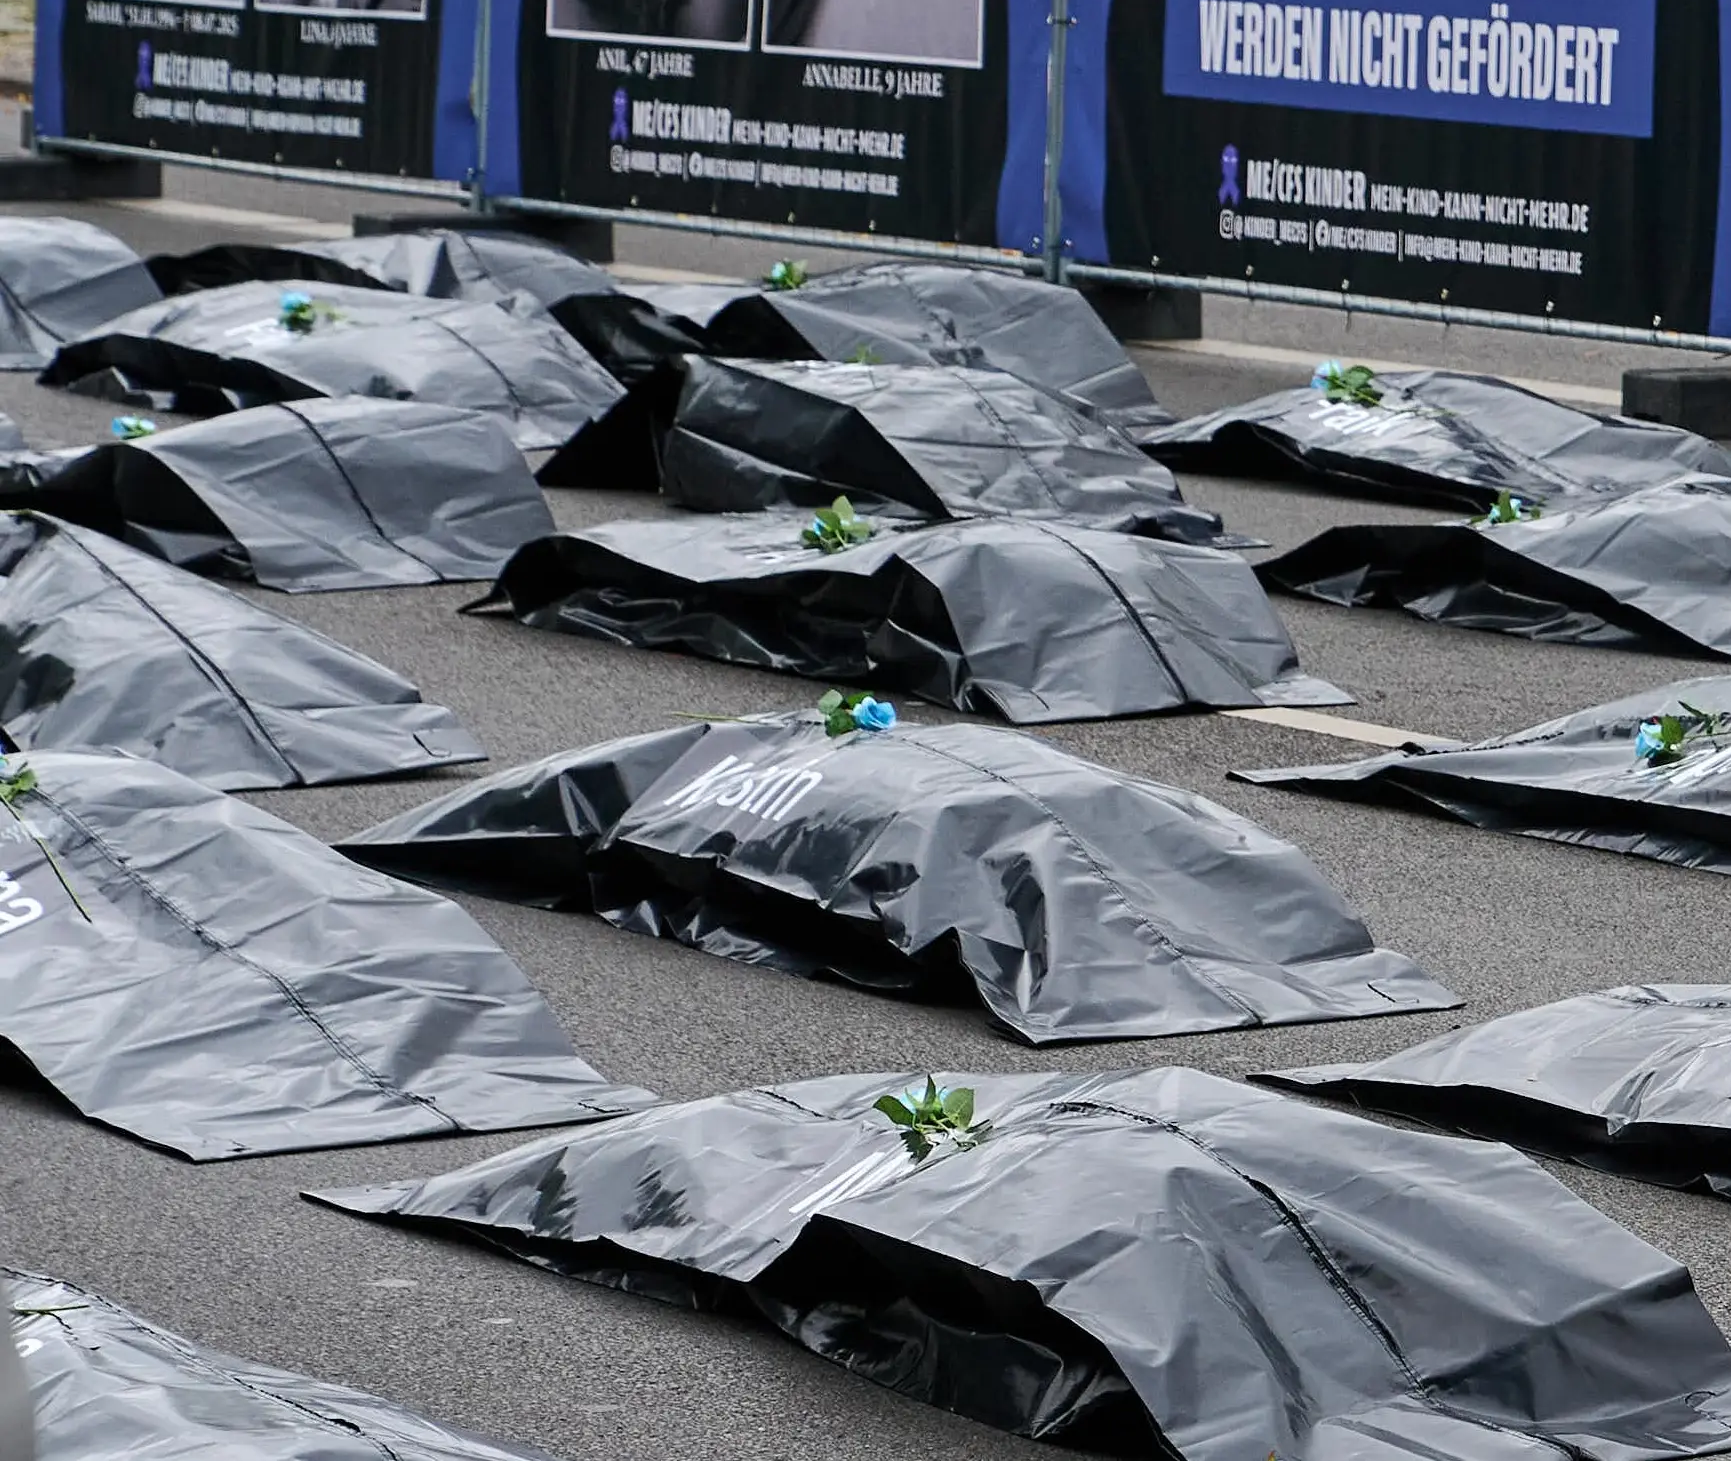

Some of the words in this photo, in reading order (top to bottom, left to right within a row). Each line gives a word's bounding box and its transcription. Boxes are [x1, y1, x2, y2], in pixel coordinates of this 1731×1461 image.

[648, 51, 694, 79] JAHRE
[1200, 0, 1323, 82] WERDEN
[1328, 8, 1423, 90] NICHT
[1427, 3, 1619, 106] GEFÖRDERT
[802, 63, 884, 95] ANNABELLE,
[885, 70, 894, 95] 9
[895, 70, 944, 98] JAHRE
[632, 98, 679, 140] ME/CFS
[681, 103, 731, 144] KINDER
[1246, 158, 1304, 205] ME/CFS
[1305, 166, 1367, 211] KINDER
[1370, 184, 1590, 233] MEIN-KIND-KANN-NICHT-MEHR.DE
